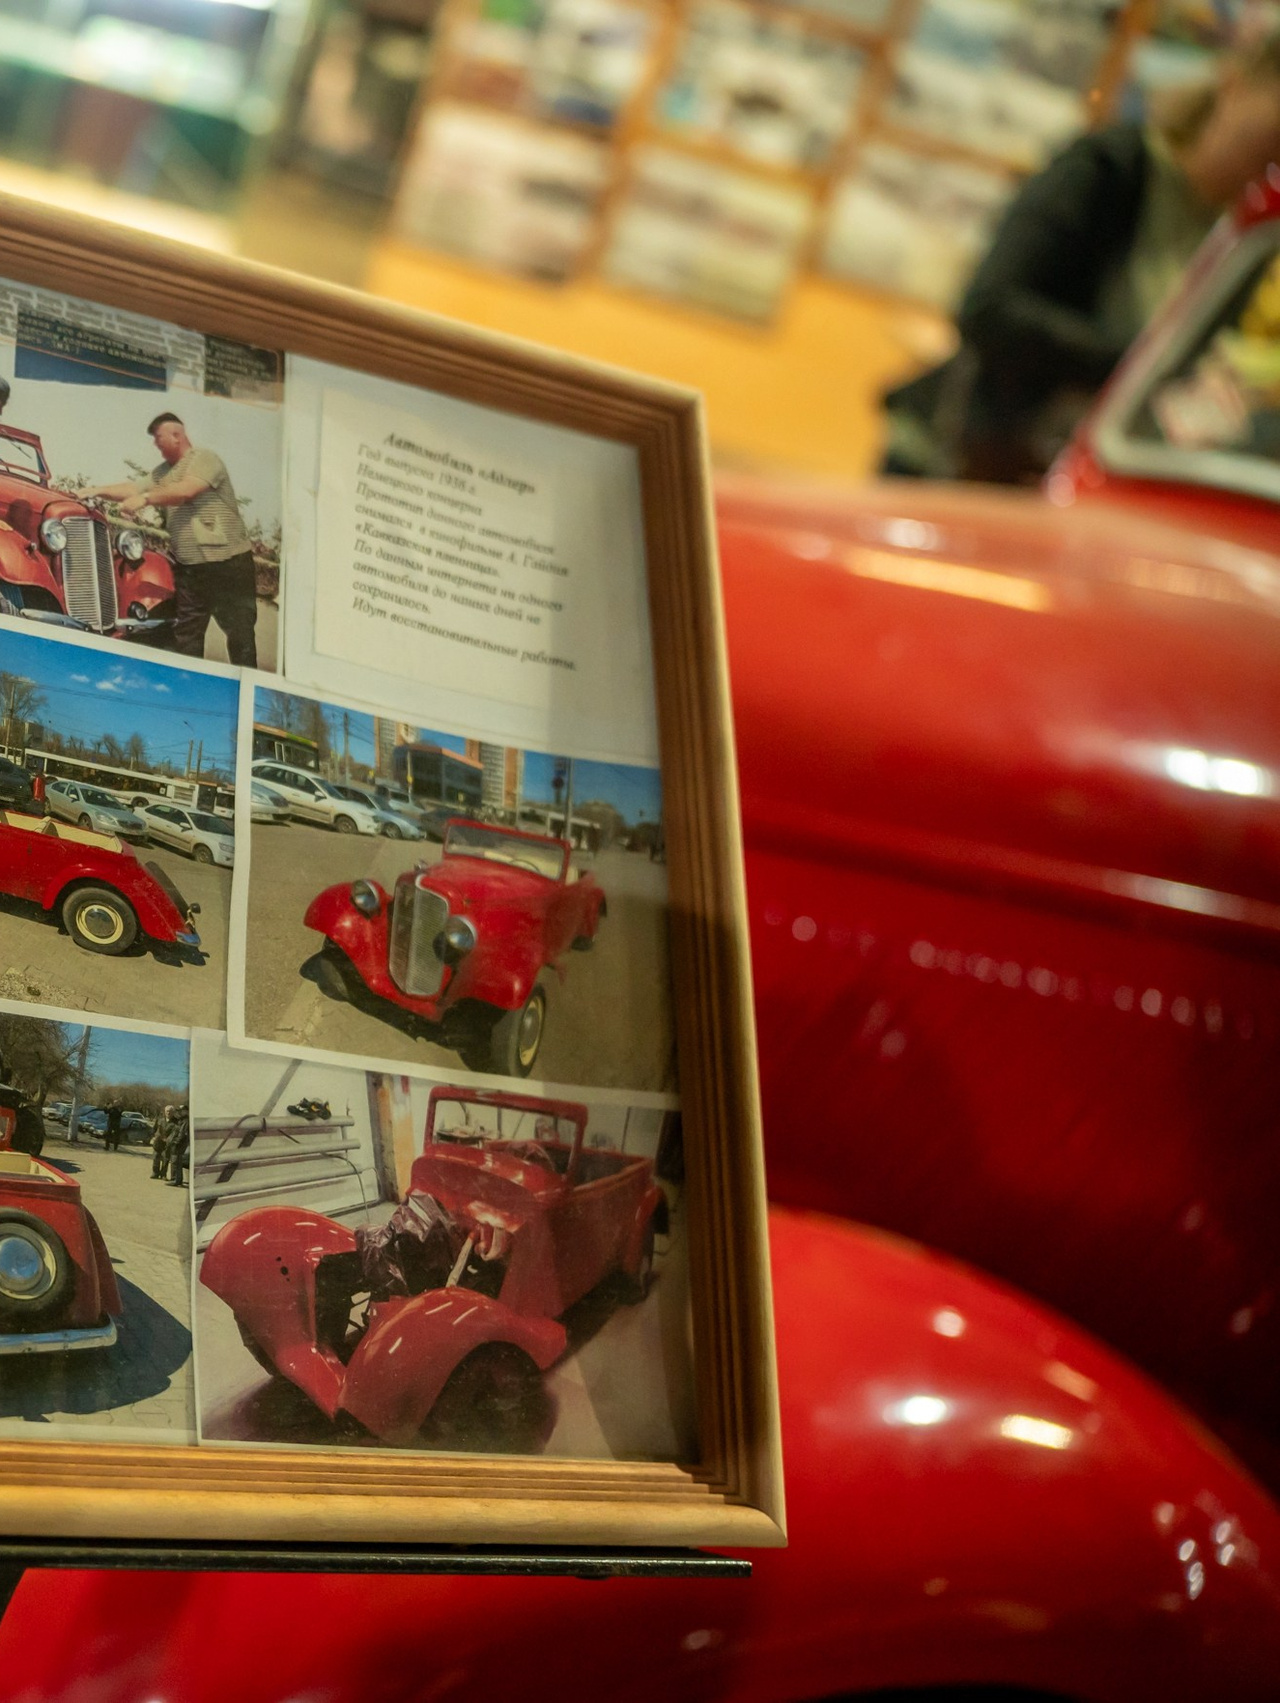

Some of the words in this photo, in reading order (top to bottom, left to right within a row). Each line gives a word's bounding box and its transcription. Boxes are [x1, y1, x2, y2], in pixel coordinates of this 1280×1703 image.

[357, 443, 382, 462] Год
[384, 457, 435, 482] выпуска
[384, 432, 473, 475] Автомобиль
[356, 462, 424, 497] Немецкого
[426, 490, 482, 517] концерна
[356, 481, 423, 516] Прототип
[426, 508, 475, 533] данного
[478, 526, 555, 554] автомобиля
[354, 503, 412, 530] снимался
[429, 528, 503, 560] кинофильме
[355, 521, 432, 555] «Кавказская
[352, 561, 429, 594] автомобиля
[432, 586, 447, 600] до
[493, 602, 523, 621] дней
[352, 580, 431, 615] сохранилось.
[354, 539, 372, 556] По
[375, 547, 424, 573] данным
[427, 565, 497, 596] интернета
[518, 592, 563, 613] одного
[352, 596, 388, 619] Идут
[390, 613, 518, 658] восстановительные
[520, 650, 577, 671] работы.
